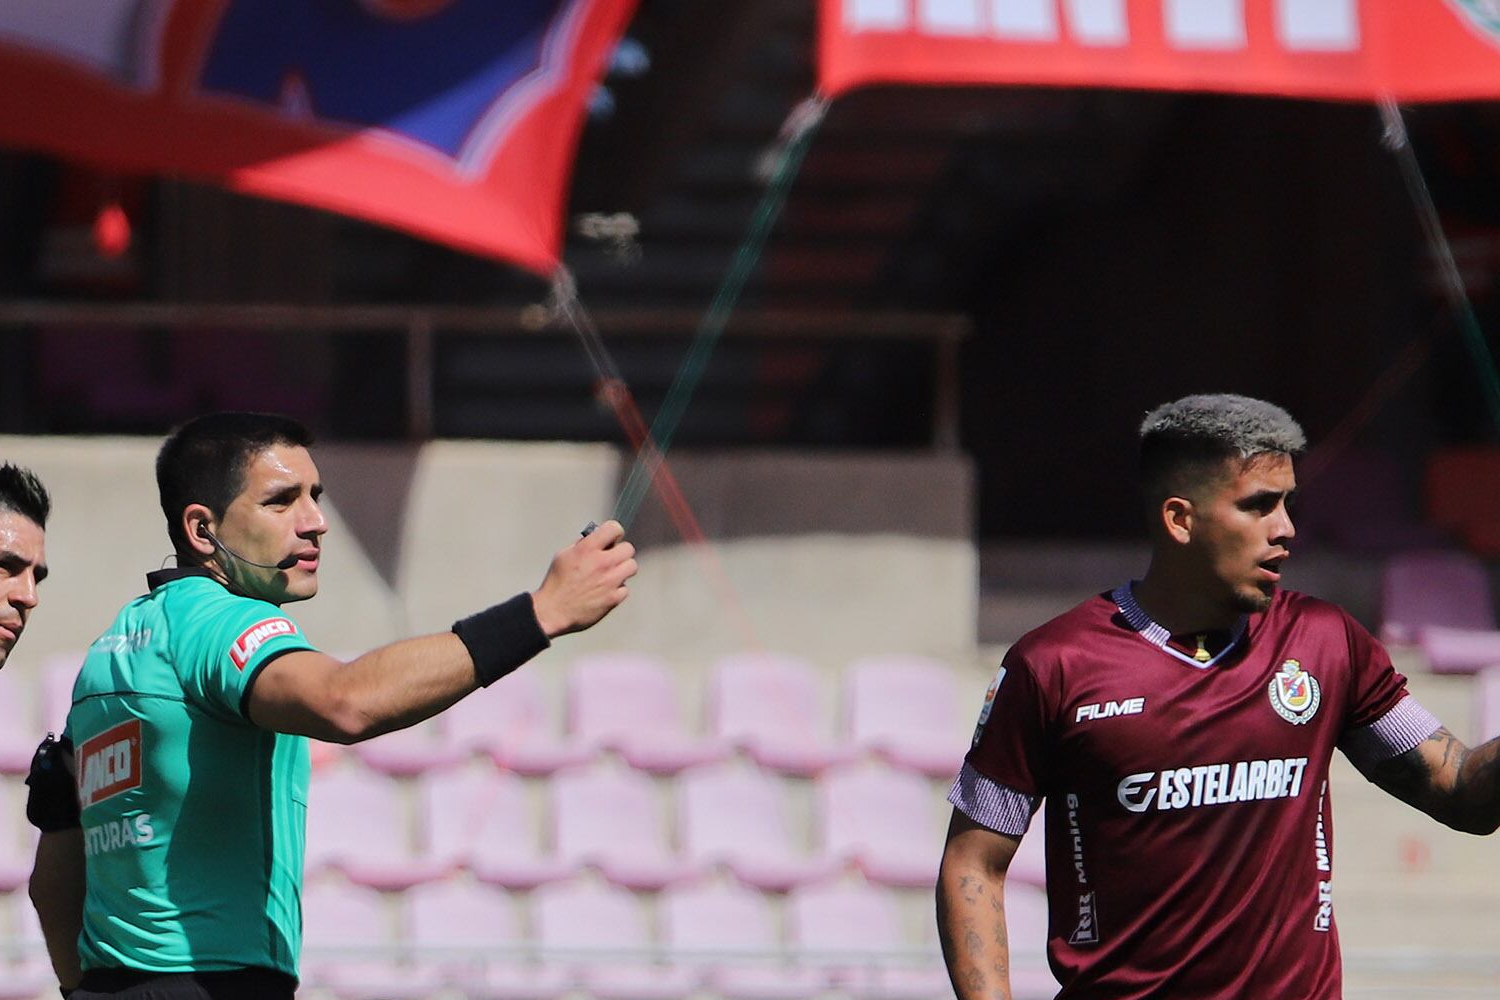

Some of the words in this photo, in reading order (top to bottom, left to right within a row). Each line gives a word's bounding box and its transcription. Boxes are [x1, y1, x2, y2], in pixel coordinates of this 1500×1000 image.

[230, 619, 295, 667] LANCO
[1075, 698, 1144, 723] FIUME
[1156, 757, 1308, 810] ESTELARBET
